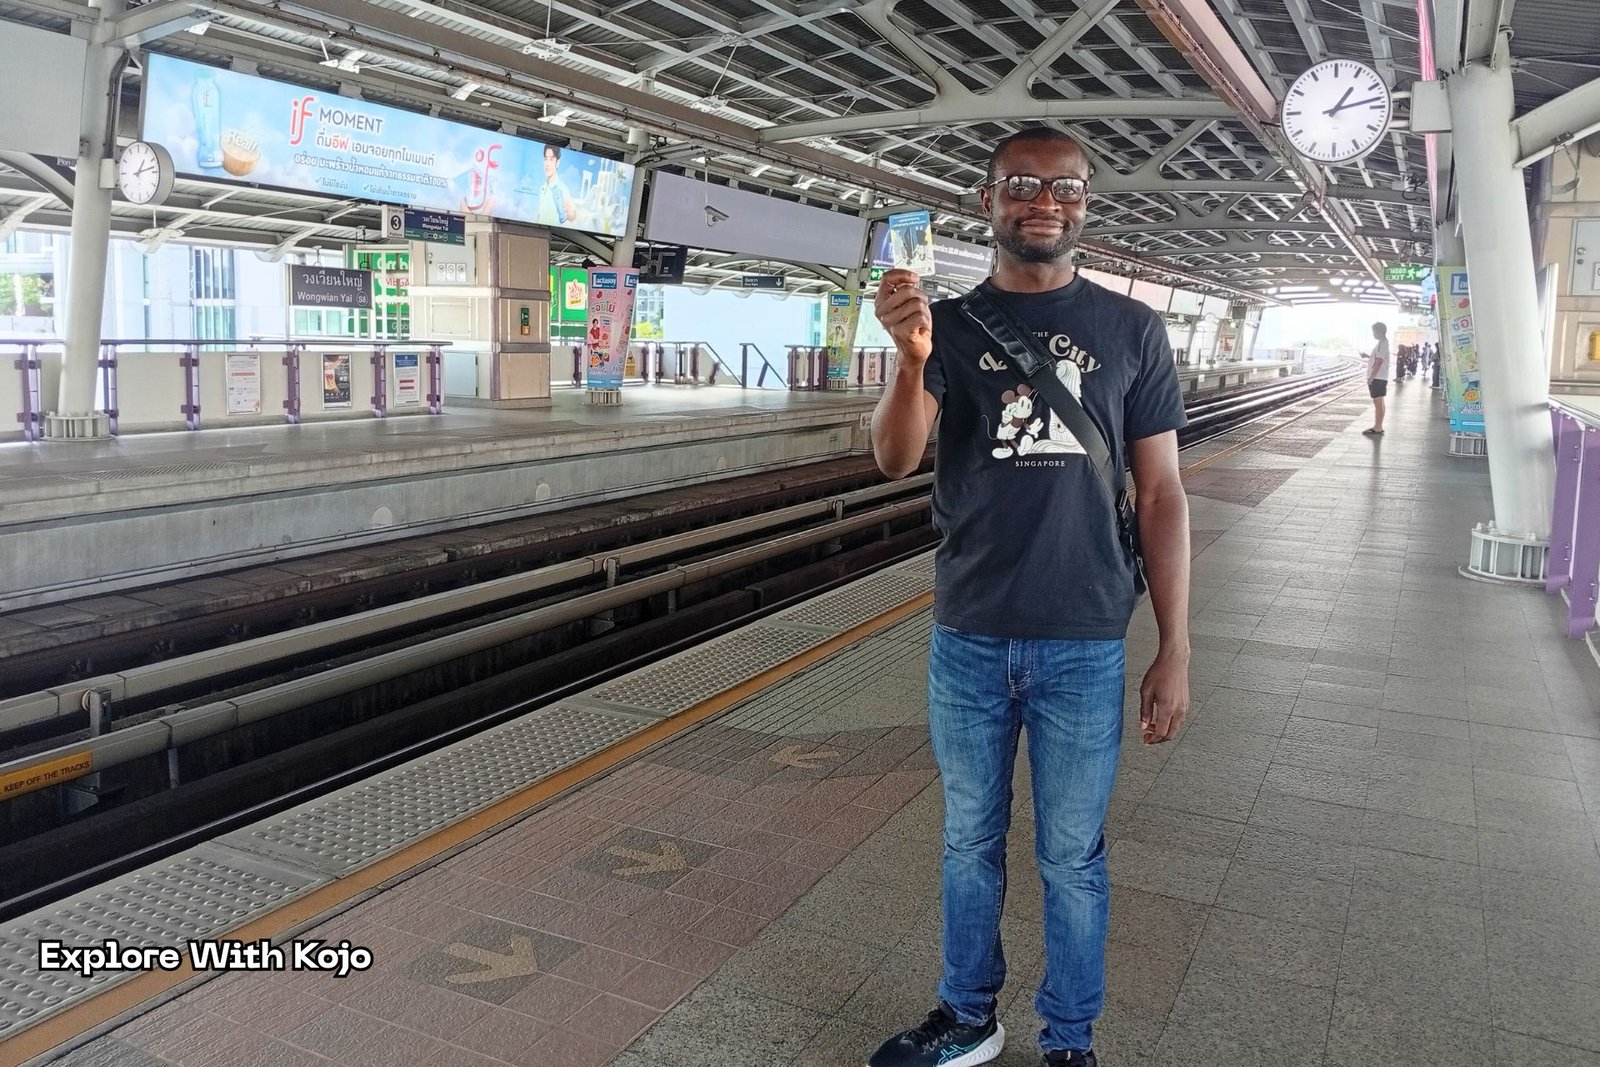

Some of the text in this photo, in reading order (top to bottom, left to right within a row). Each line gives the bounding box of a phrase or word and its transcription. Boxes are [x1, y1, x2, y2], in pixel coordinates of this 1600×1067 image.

[290, 97, 315, 145] if
[319, 107, 384, 133] MOMENT
[392, 216, 400, 230] 3
[302, 269, 363, 291] วงเวียนใหญ่
[593, 274, 617, 288] Lactasoy
[297, 291, 353, 303] Wongwian Yai
[391, 321, 408, 331] Gab
[1049, 333, 1101, 374] City
[4, 760, 90, 792] KEEP OFF THE TRACKS
